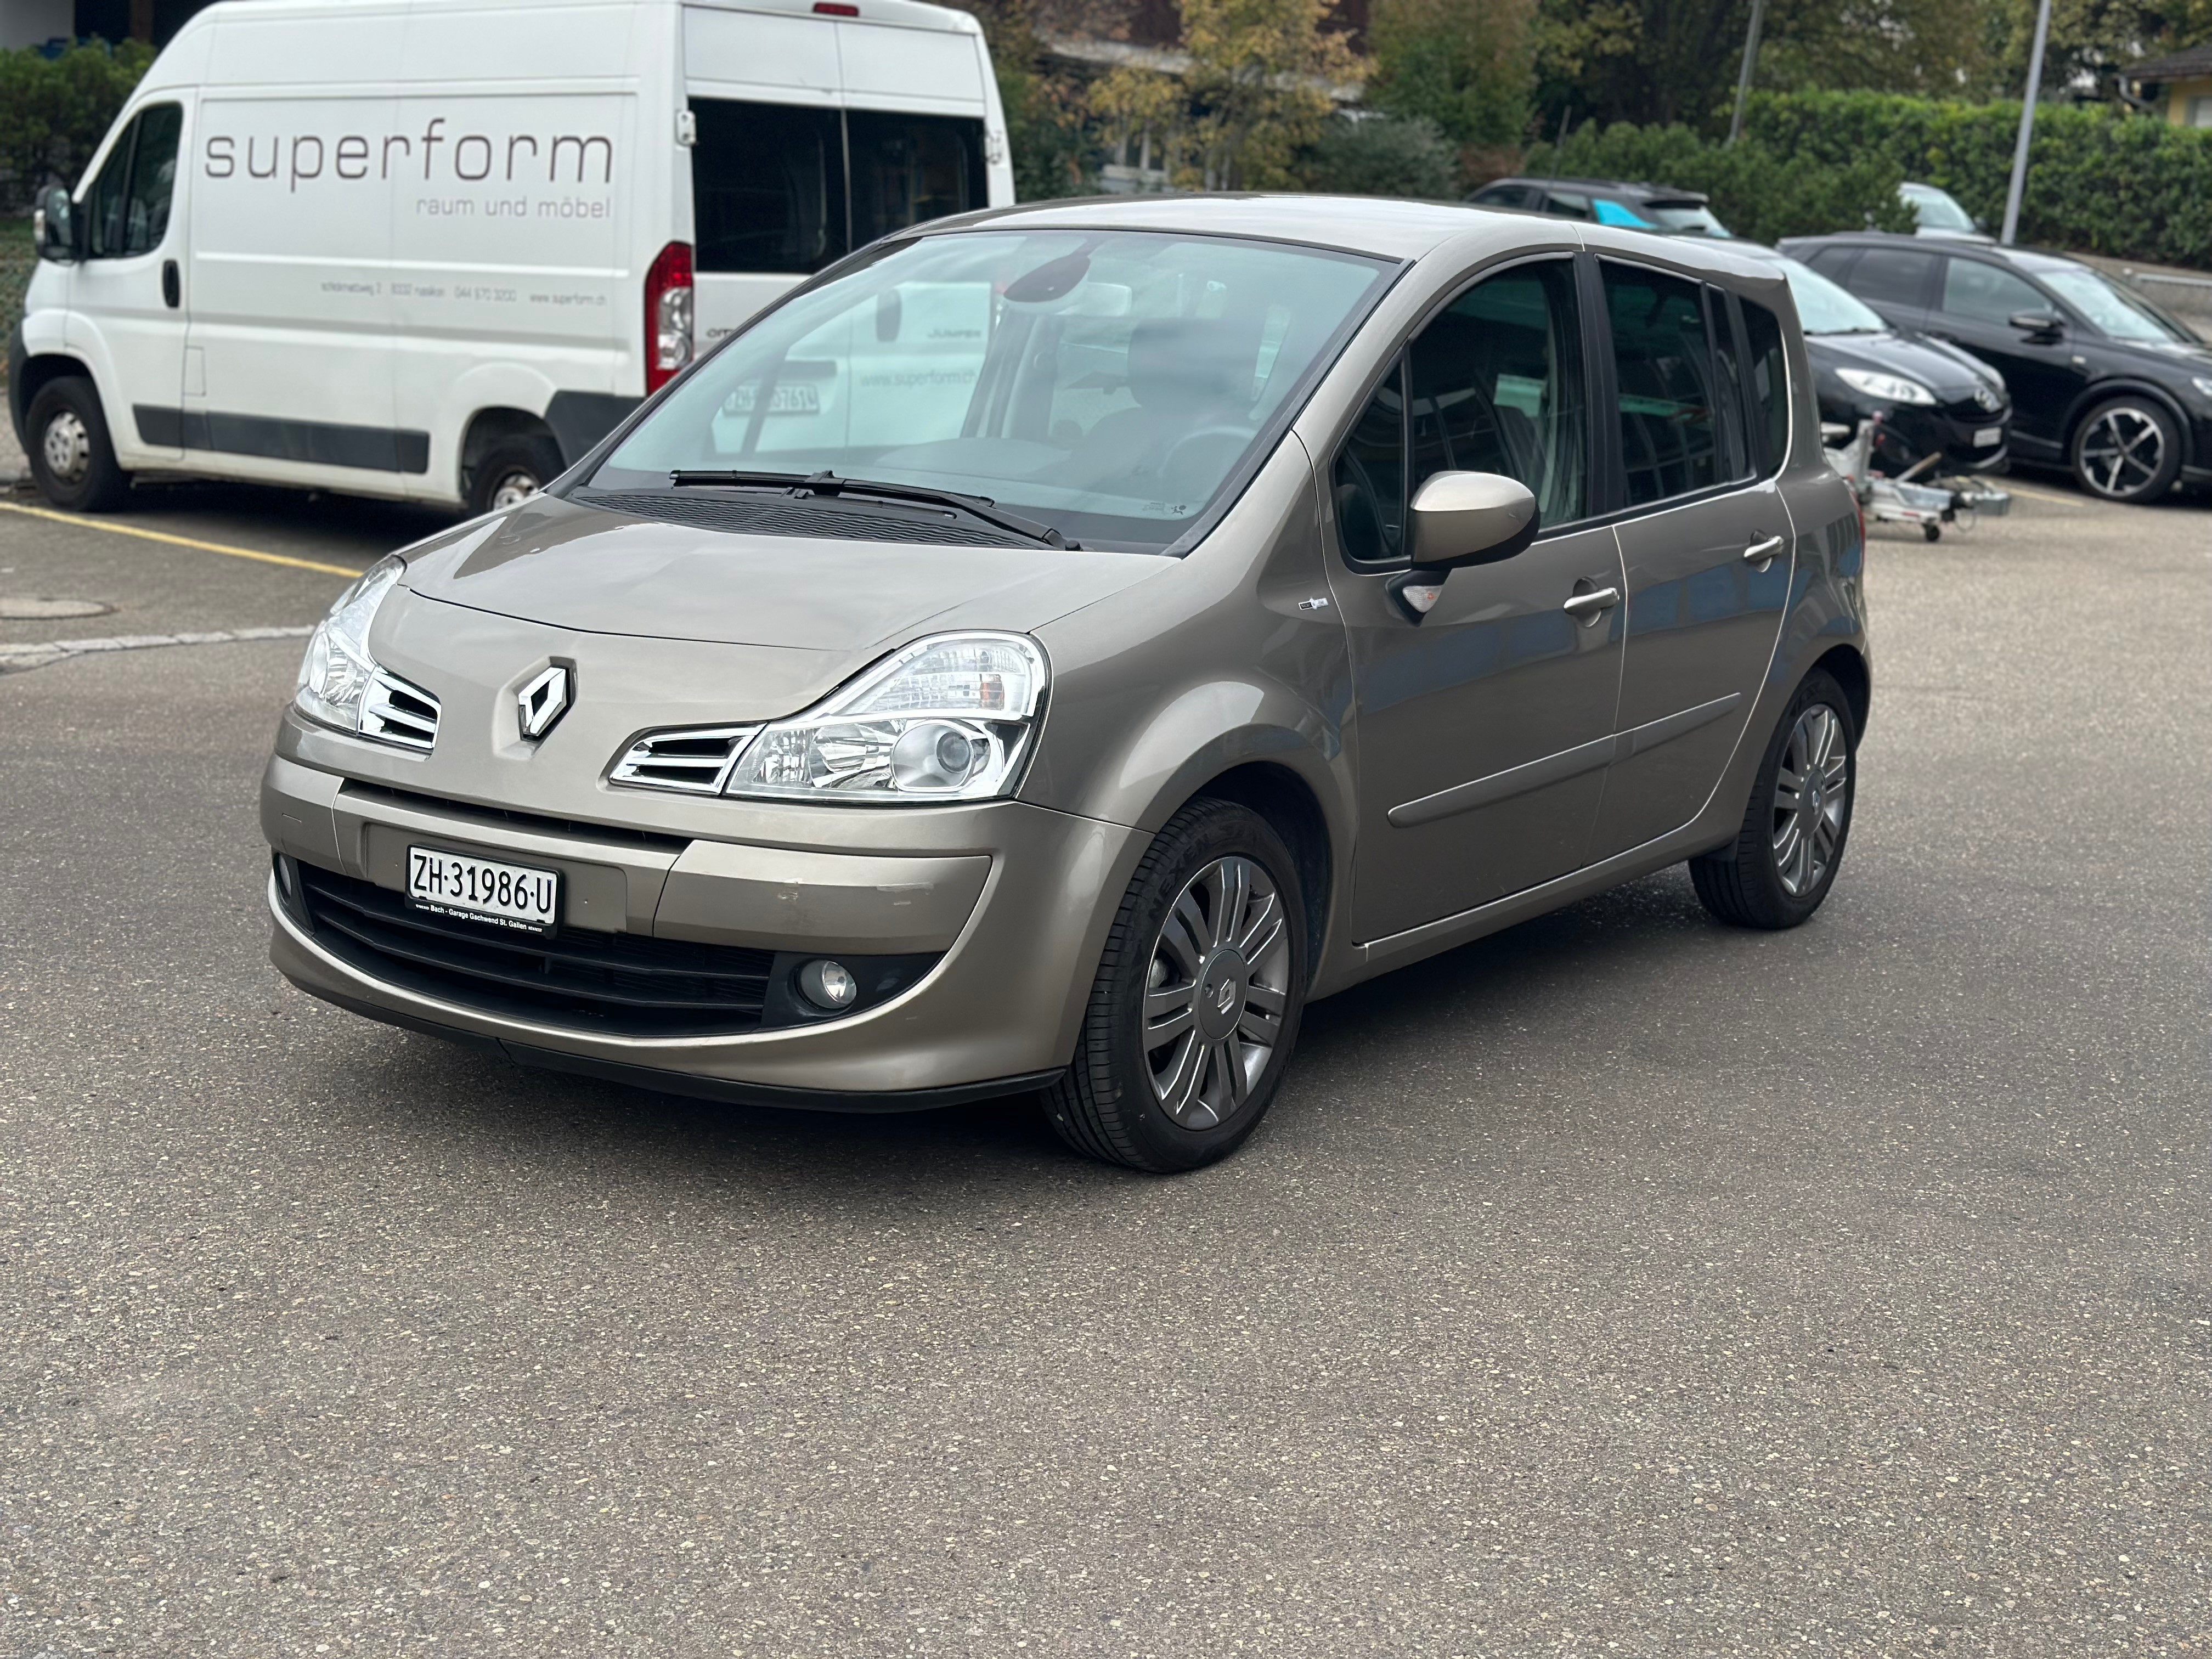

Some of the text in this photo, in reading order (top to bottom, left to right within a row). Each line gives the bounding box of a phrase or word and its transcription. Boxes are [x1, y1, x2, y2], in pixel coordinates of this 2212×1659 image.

[205, 117, 613, 193] superform
[416, 196, 611, 219] raum und möbel
[430, 905, 444, 913] Bach
[448, 909, 469, 919] Garage
[469, 912, 499, 924] Gschwend
[509, 920, 527, 930] Gallen
